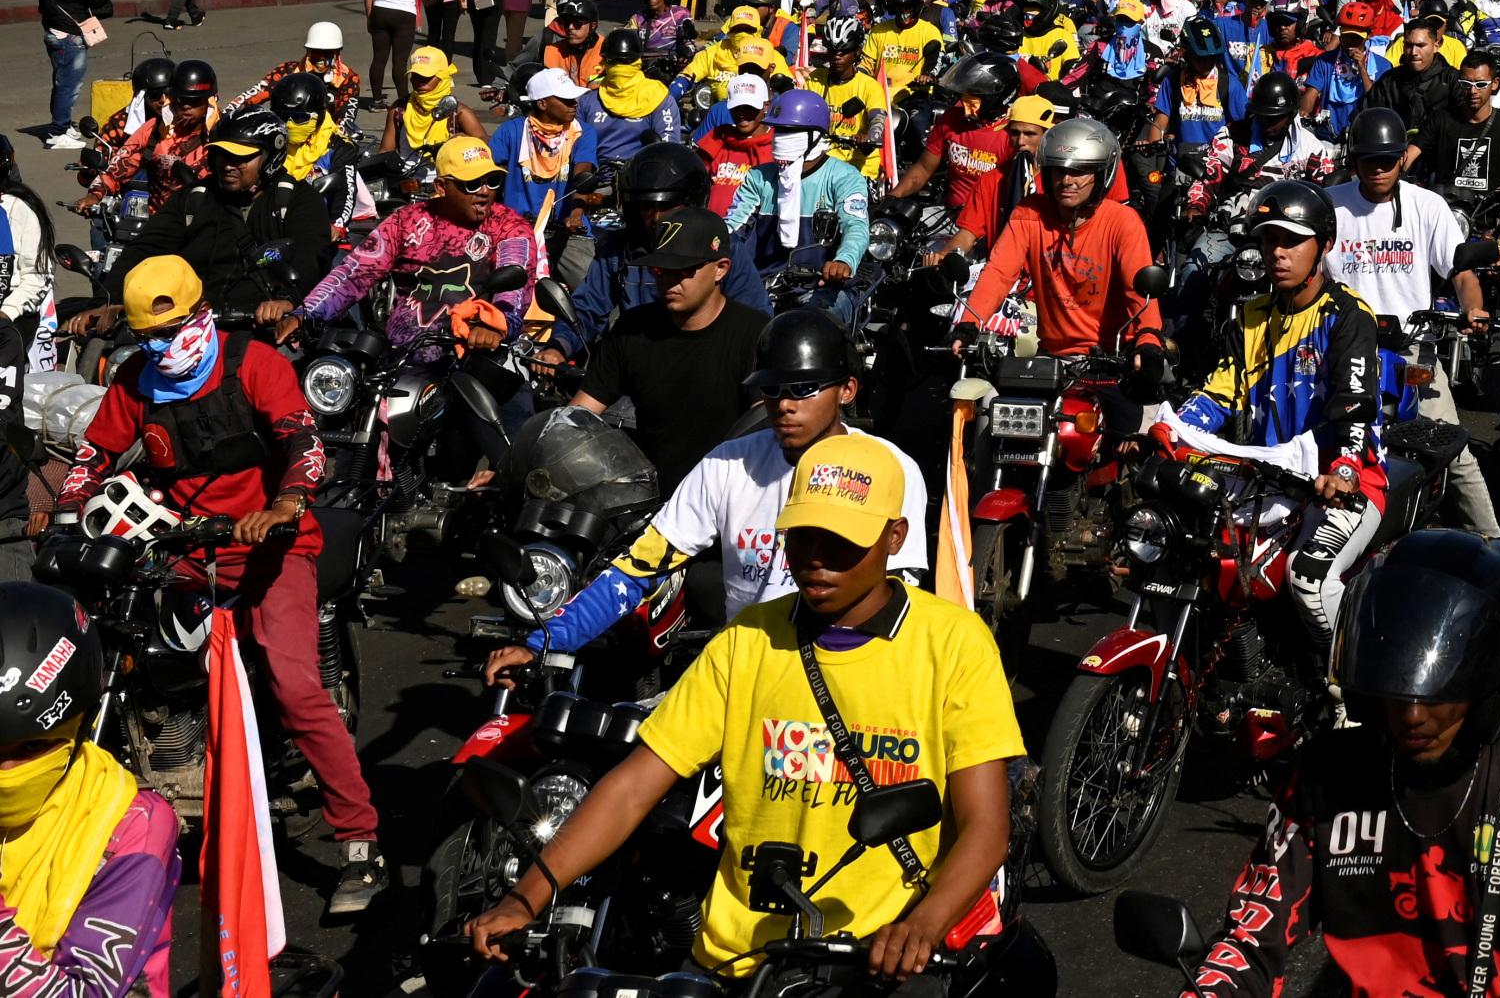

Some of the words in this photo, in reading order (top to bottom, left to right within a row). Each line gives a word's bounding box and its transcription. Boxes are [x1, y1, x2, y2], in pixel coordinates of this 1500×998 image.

[593, 112, 608, 122] 27
[1456, 178, 1485, 187] adidas
[1376, 241, 1413, 251] JURO
[1376, 251, 1414, 265] MADURO
[1342, 262, 1359, 274] POR
[1361, 262, 1375, 274] EL
[1376, 262, 1414, 274] FUTURO
[809, 475, 838, 487] CON
[842, 466, 872, 485] JURO
[806, 484, 821, 495] POR
[822, 485, 833, 496] EL
[742, 565, 765, 582] POR
[25, 636, 77, 694] YAMAHA
[36, 690, 73, 730] FOX
[764, 719, 810, 751] YO
[807, 662, 830, 705] YOUNG
[854, 762, 874, 793] YOU
[851, 723, 861, 731] 10
[882, 727, 917, 737] ENERO
[764, 750, 835, 784] CON
[762, 774, 800, 801] POR
[802, 781, 825, 809] EL
[1329, 810, 1387, 855] 04
[1338, 866, 1376, 876] ROMAN
[1476, 913, 1497, 960] YOUNG
